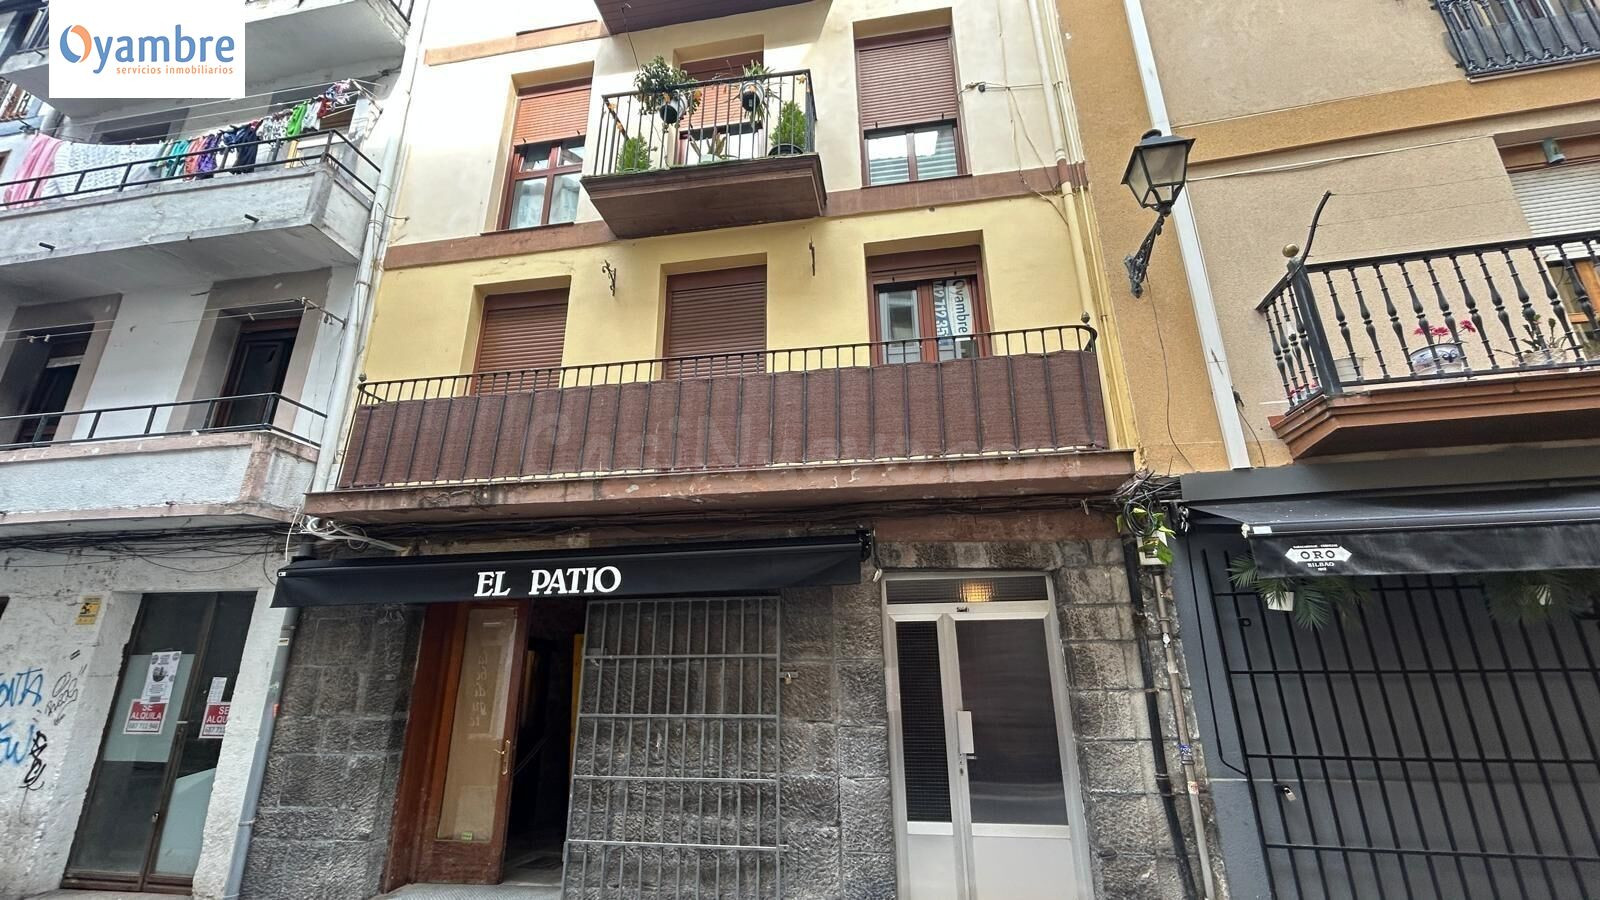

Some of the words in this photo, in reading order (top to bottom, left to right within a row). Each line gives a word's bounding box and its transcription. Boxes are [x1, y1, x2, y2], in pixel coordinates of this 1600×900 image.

[1301, 551, 1335, 560] ORO
[474, 571, 511, 597] EL
[528, 566, 622, 595] PATIO
[130, 711, 163, 720] ALQUILA
